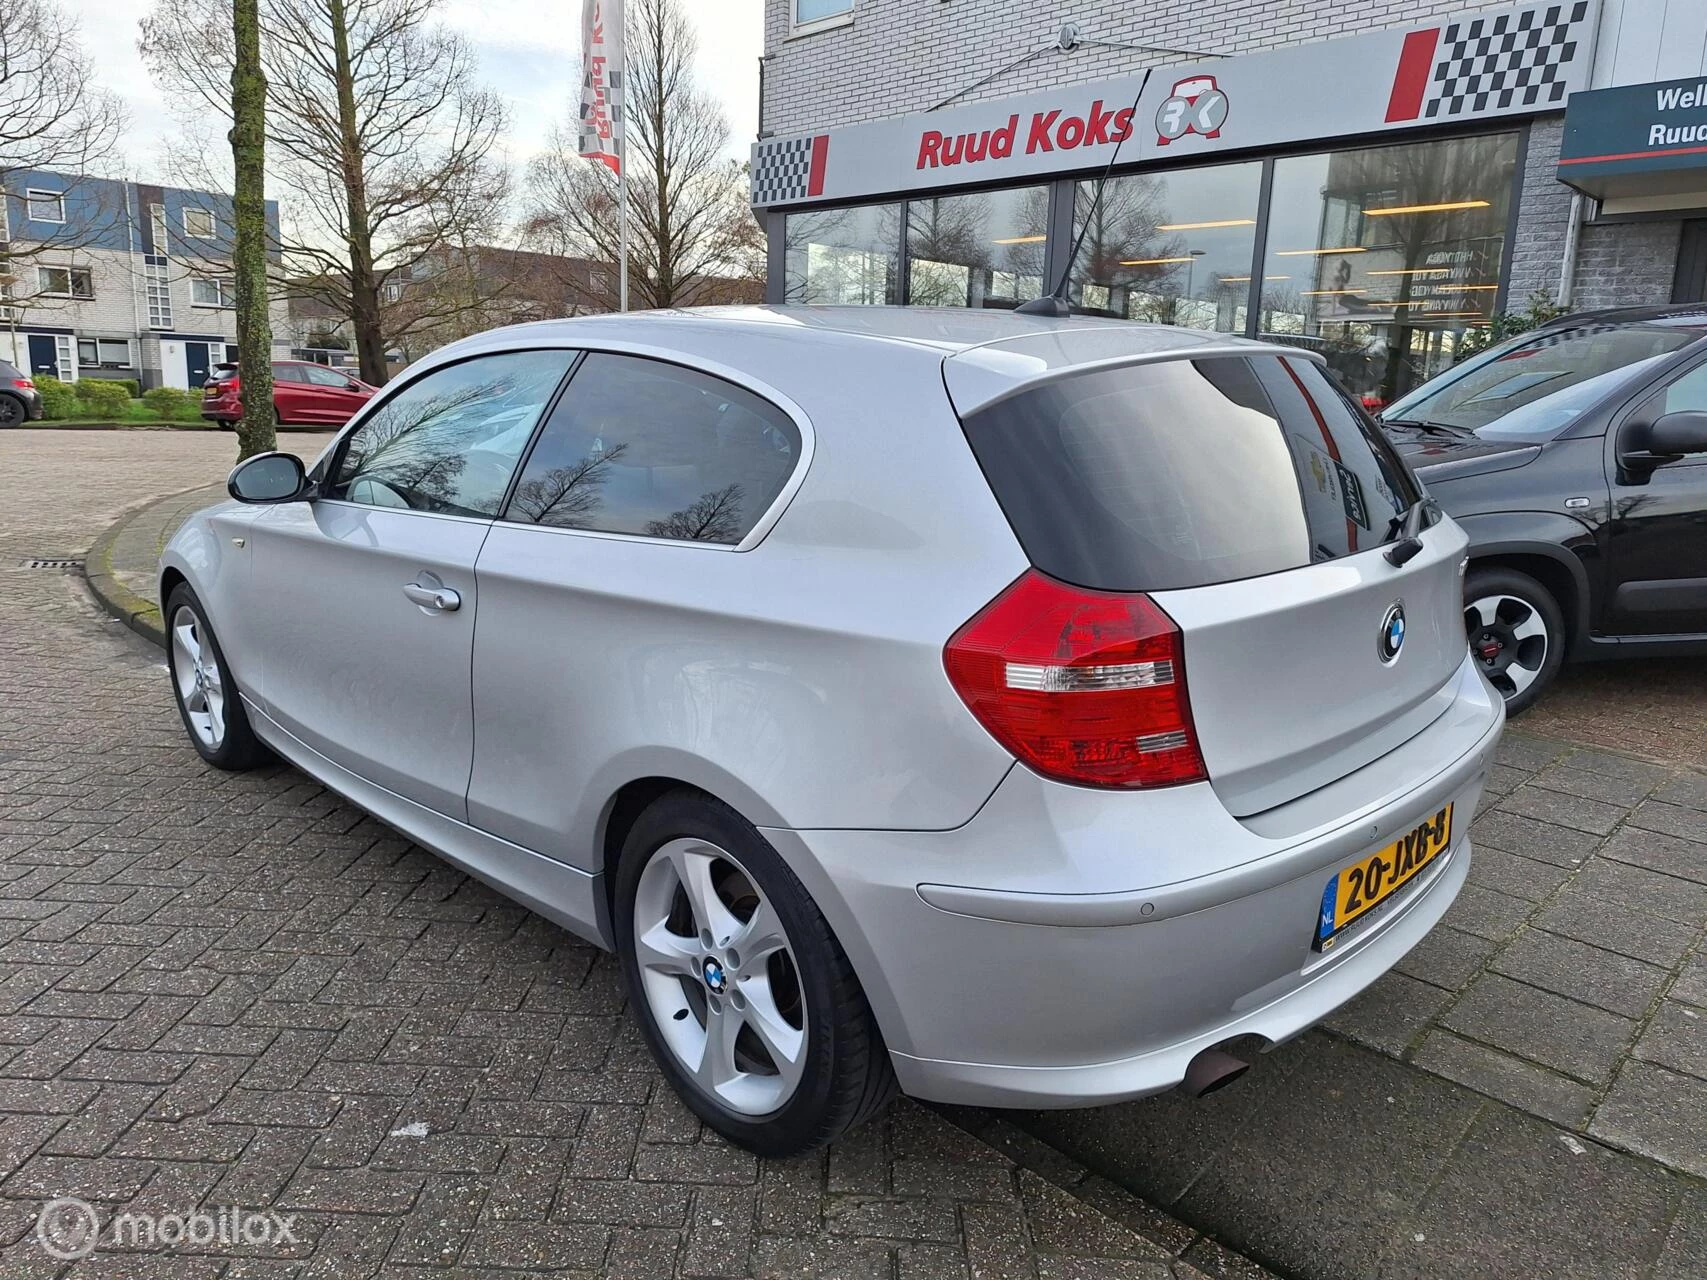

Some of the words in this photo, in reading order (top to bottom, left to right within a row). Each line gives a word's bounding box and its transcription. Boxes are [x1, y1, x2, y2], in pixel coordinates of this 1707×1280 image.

[916, 113, 1019, 170] Ruud
[1025, 100, 1136, 154] Koks
[1344, 808, 1446, 914] 20-JXB-8
[1321, 911, 1334, 927] NL
